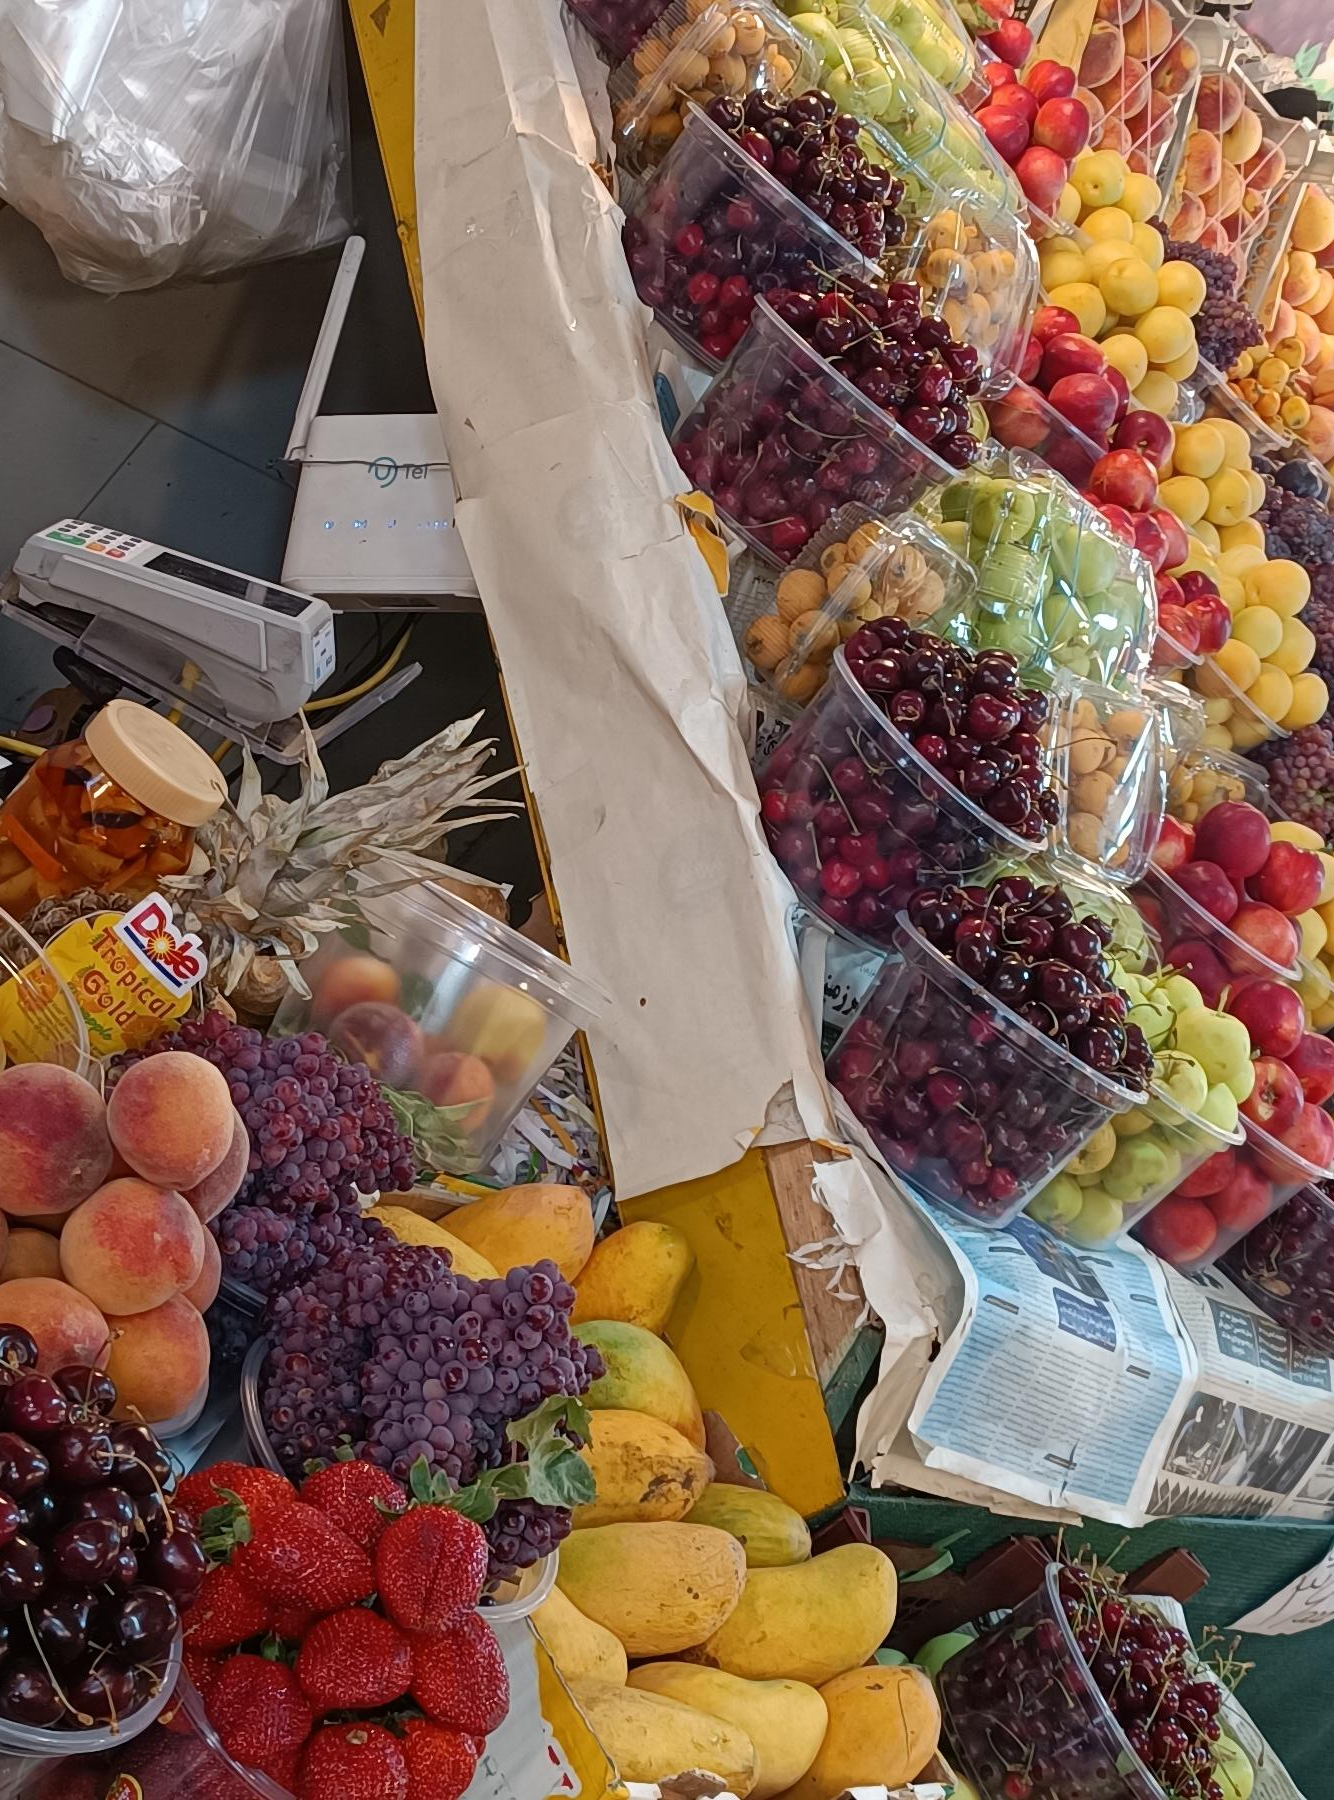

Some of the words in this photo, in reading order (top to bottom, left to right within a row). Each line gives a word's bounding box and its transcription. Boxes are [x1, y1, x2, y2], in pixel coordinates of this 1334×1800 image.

[91, 926, 176, 1019] Tropical
[130, 902, 200, 980] Dole
[83, 969, 138, 1028] Gold
